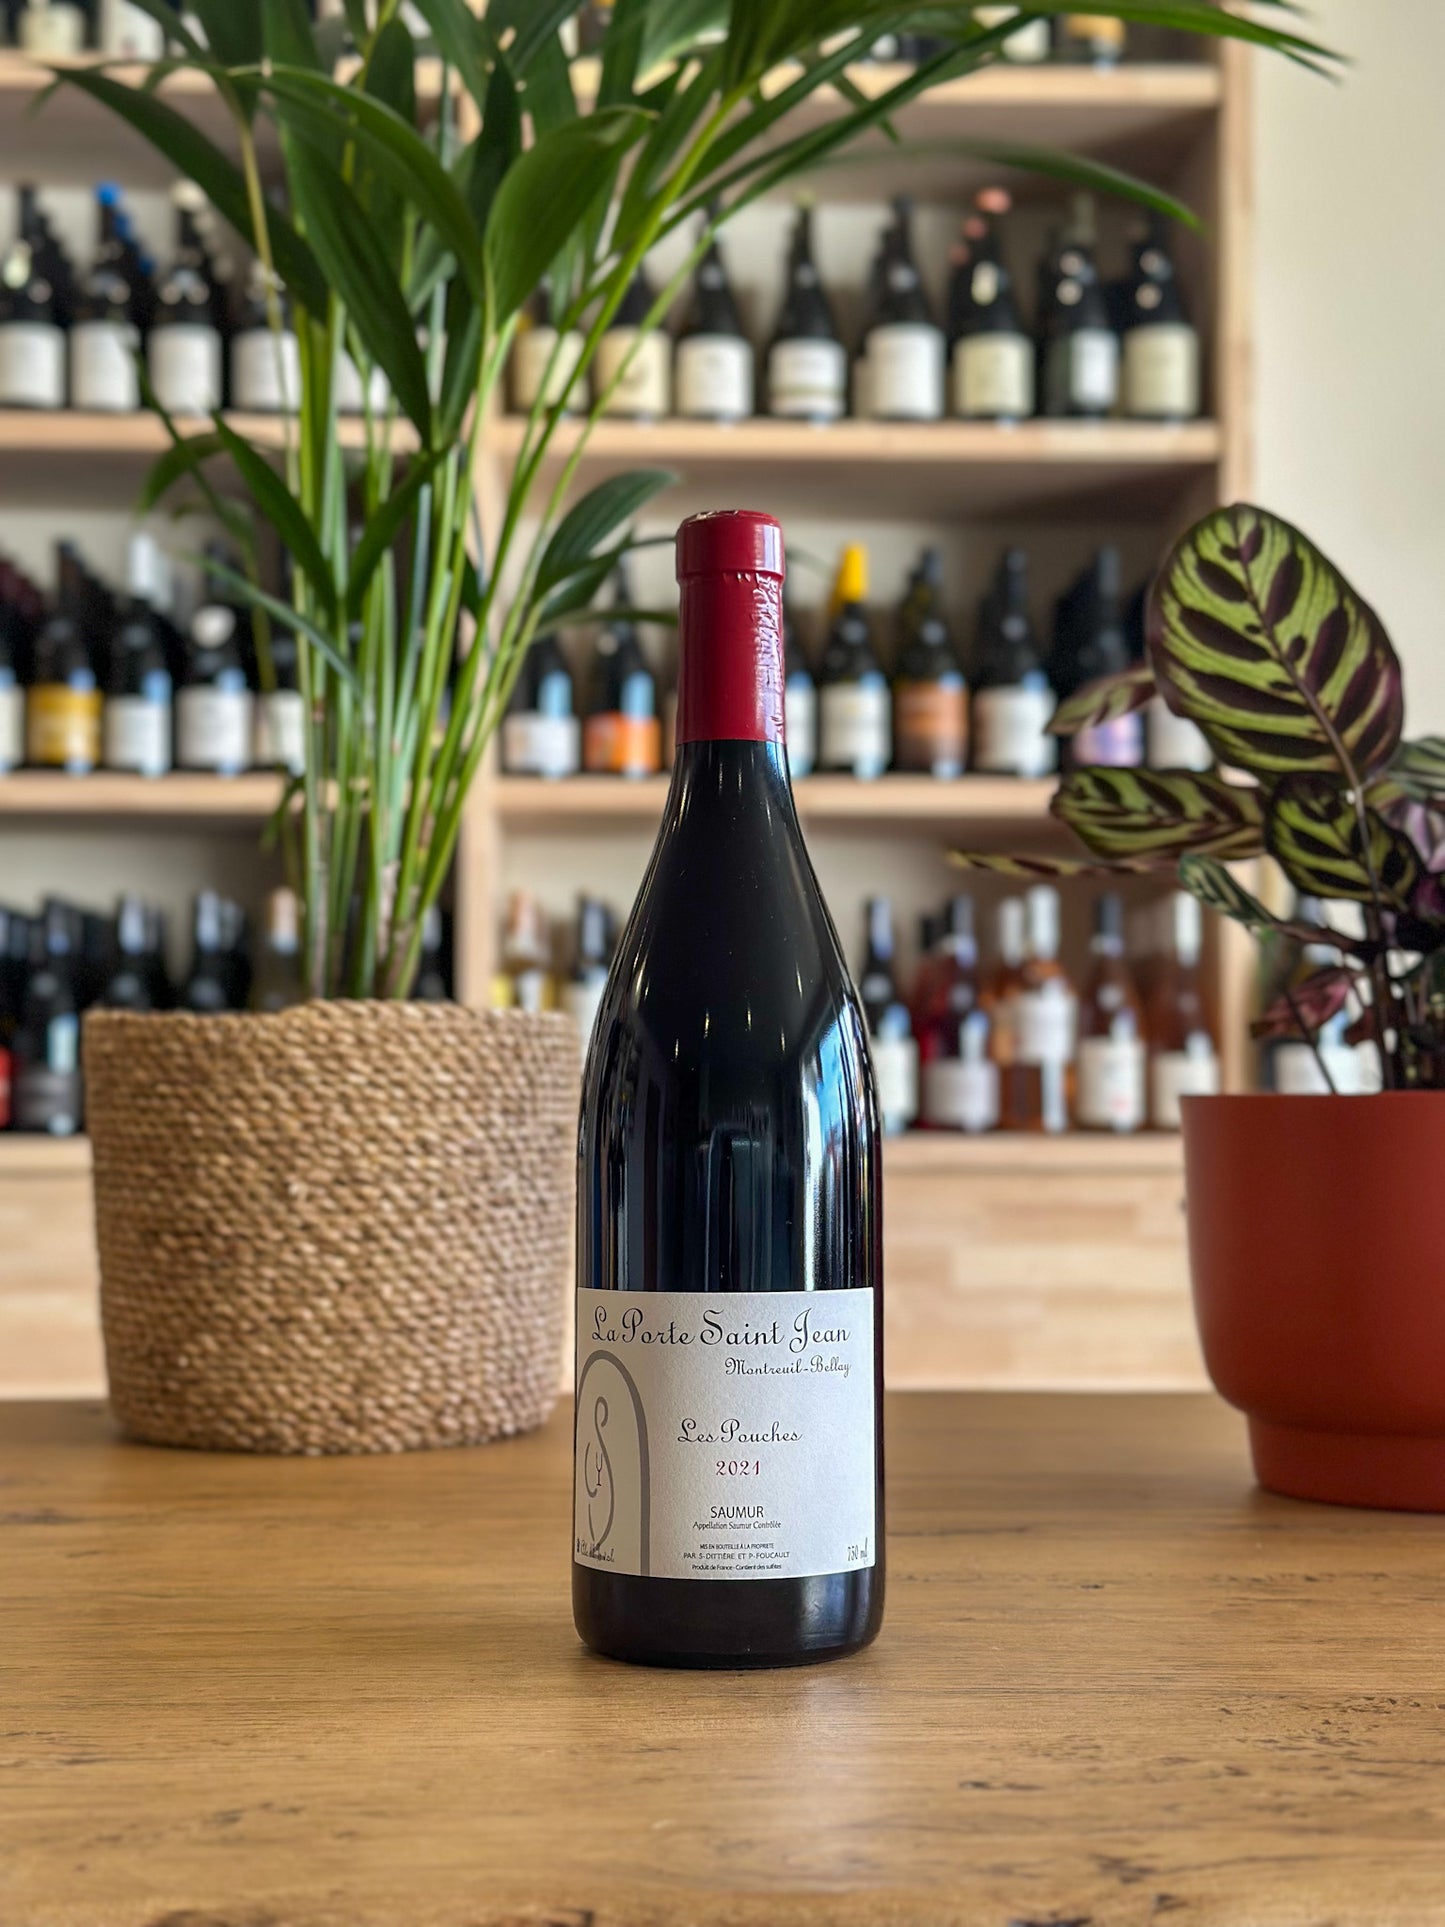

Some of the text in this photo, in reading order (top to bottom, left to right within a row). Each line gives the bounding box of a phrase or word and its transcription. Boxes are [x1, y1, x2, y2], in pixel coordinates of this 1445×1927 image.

[592, 1305, 851, 1354] La Porte Saint Jean
[724, 1354, 850, 1378] Montreuil-Bellay
[677, 1417, 803, 1443] Les Pouches
[715, 1460, 760, 1476] 2021
[710, 1505, 764, 1519] SAUMUR
[692, 1520, 782, 1531] Appellation Saumur Contrôlée
